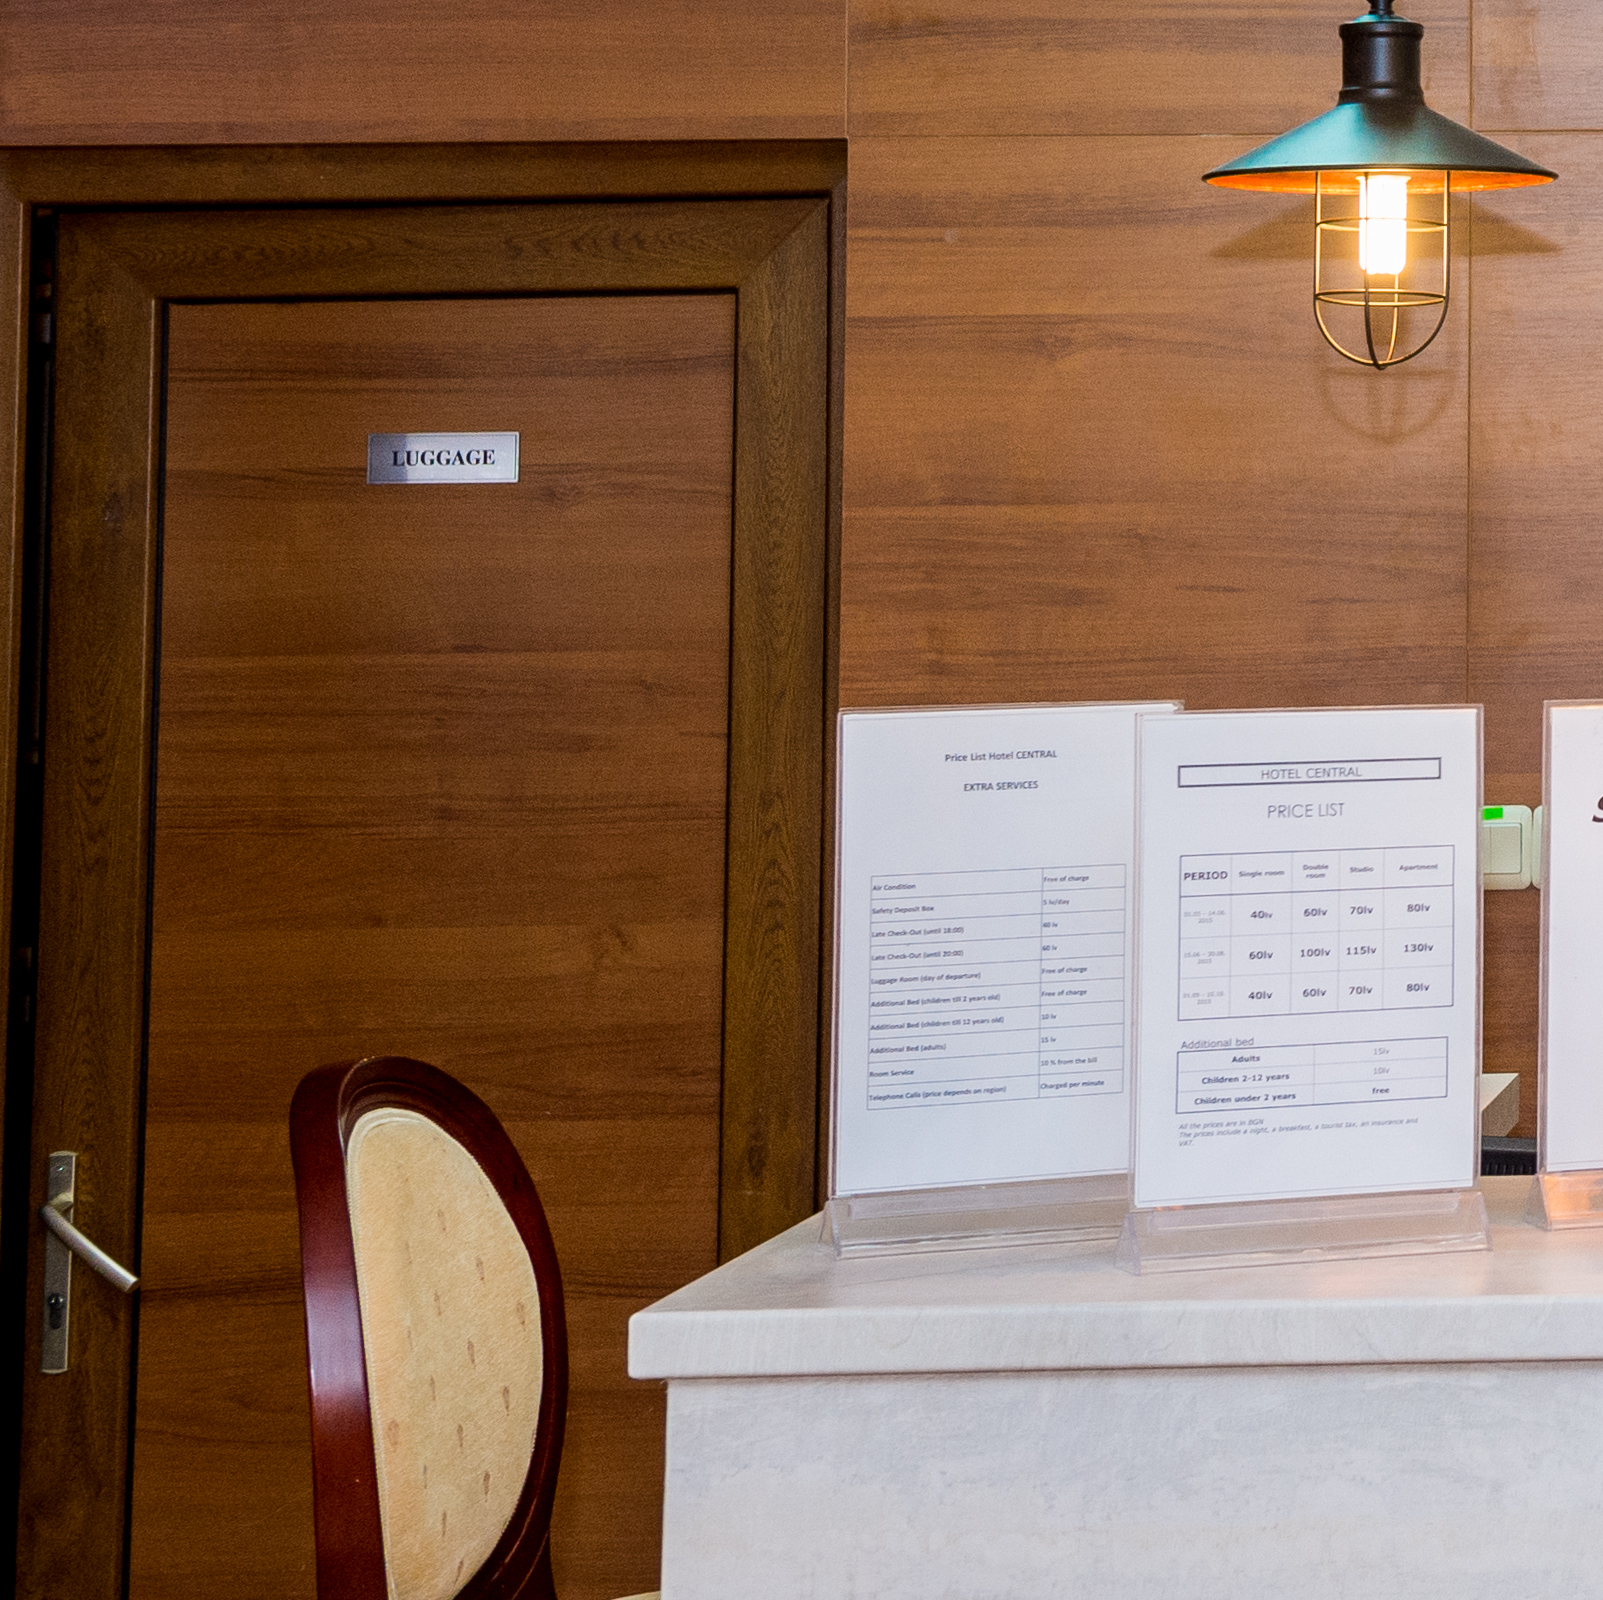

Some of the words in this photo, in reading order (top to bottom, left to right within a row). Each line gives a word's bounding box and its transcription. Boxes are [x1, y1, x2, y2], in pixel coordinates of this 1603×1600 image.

[392, 450, 496, 467] LUGGAGE
[944, 753, 968, 763] Price
[970, 752, 986, 761] List
[988, 751, 1014, 761] Hotel
[1016, 749, 1058, 760] CENTRAL
[1261, 767, 1301, 780] HOTEL
[1306, 766, 1362, 779] CENTRAL
[963, 782, 994, 792] EXTRA
[996, 780, 1039, 791] SERVICES
[1267, 803, 1314, 819] PRICE
[1318, 802, 1345, 817] LIST
[1183, 870, 1228, 882] PERIOD
[1250, 910, 1274, 920] 40lv
[1303, 907, 1328, 917] 60lv
[1349, 905, 1374, 915] 70lv
[1406, 903, 1431, 913] 80lv
[1249, 950, 1274, 960] 60lv
[1300, 948, 1331, 958] 100lv
[1346, 945, 1377, 955] 115lv
[1403, 943, 1434, 953] 130lv
[1248, 990, 1273, 1000] 40lv
[1302, 988, 1327, 998] 60lv
[1349, 986, 1373, 996] 70lv
[1406, 983, 1430, 993] 80lv
[1180, 1037, 1233, 1050] Additional
[1235, 1037, 1255, 1048] bed
[1202, 1075, 1240, 1085] Children
[1242, 1073, 1263, 1083] 2-12
[1266, 1073, 1290, 1083] years
[1194, 1095, 1232, 1106] Children
[1234, 1094, 1261, 1104] under
[1263, 1093, 1270, 1102] 2
[1271, 1092, 1297, 1103] years
[1372, 1085, 1390, 1095] free
